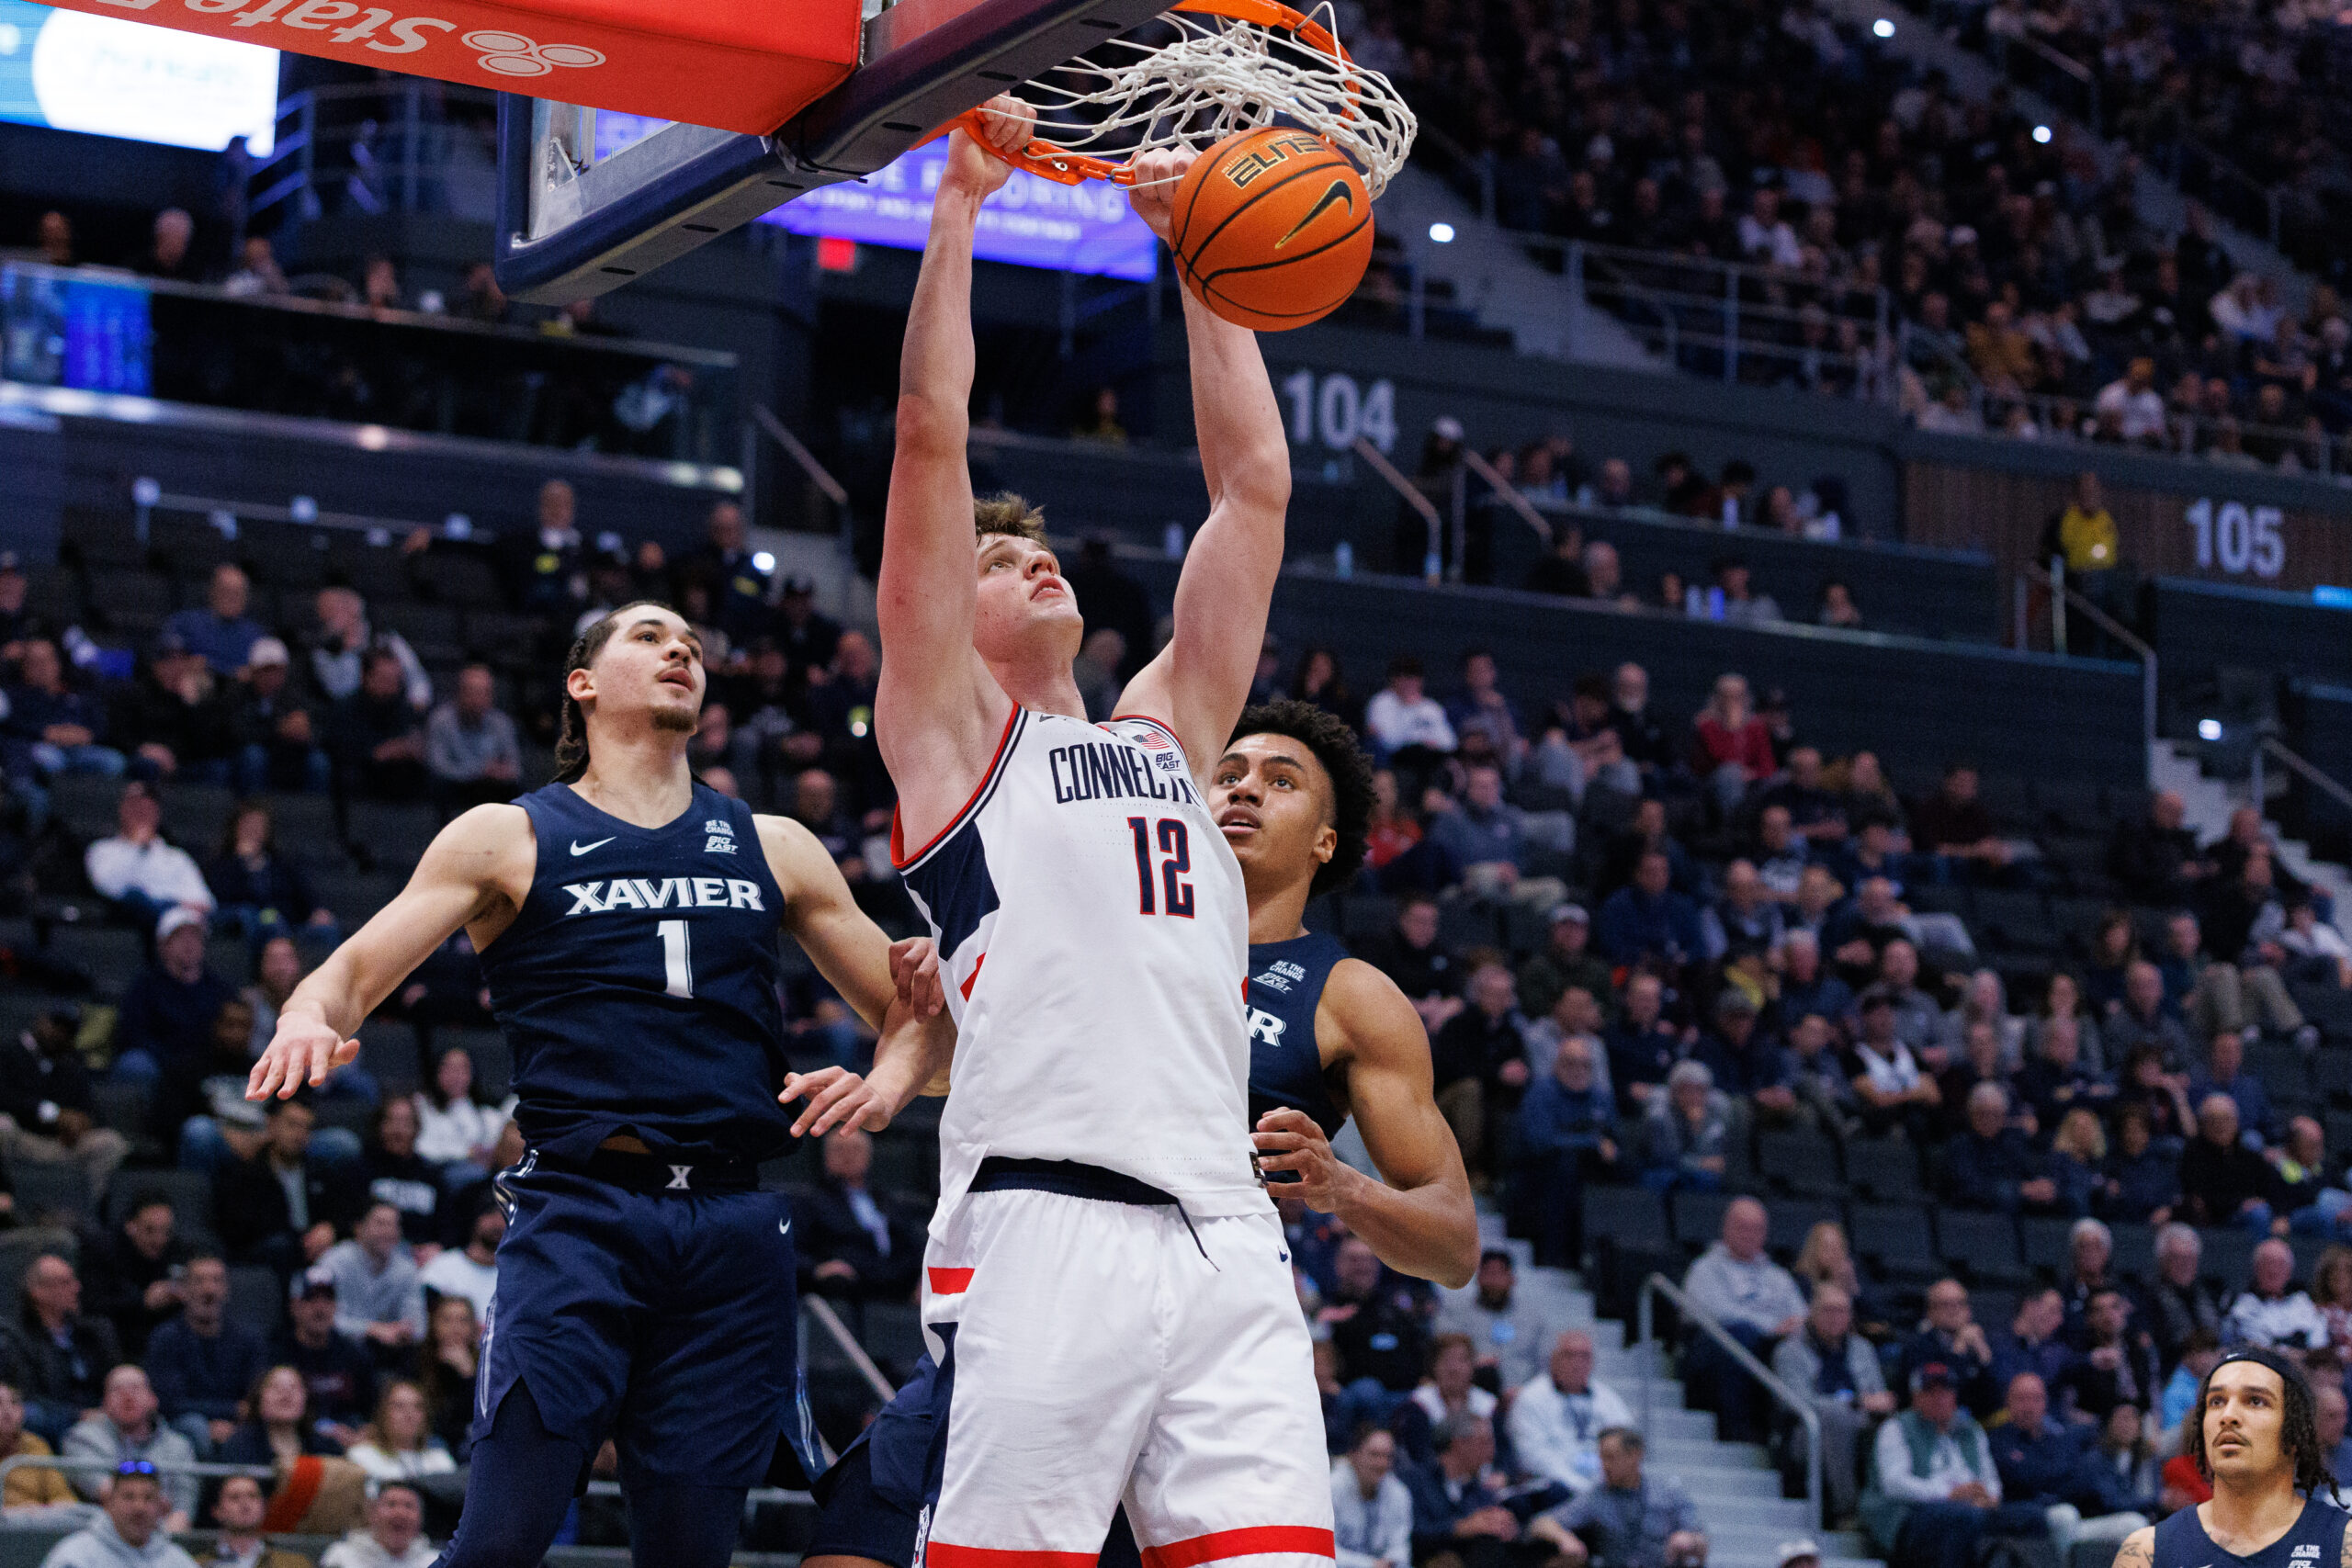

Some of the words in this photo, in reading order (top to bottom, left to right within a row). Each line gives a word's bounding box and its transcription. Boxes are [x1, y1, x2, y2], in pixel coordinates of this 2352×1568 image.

[1225, 136, 1327, 189] ELITE
[1283, 369, 1398, 455] 104
[2185, 498, 2286, 579] 105
[1156, 751, 1174, 762] BIG
[706, 819, 718, 828] BE
[705, 842, 739, 852] EAST
[707, 835, 731, 844] BIG
[1127, 816, 1195, 919] 12
[562, 876, 766, 916] XAVIER
[657, 919, 694, 998] 1
[1269, 964, 1305, 982] CHANGE
[1275, 960, 1289, 968] BE
[1290, 963, 1306, 975] THE
[1255, 976, 1294, 991] EAST
[1261, 972, 1290, 983] BIG
[2306, 1544, 2320, 1552] THE
